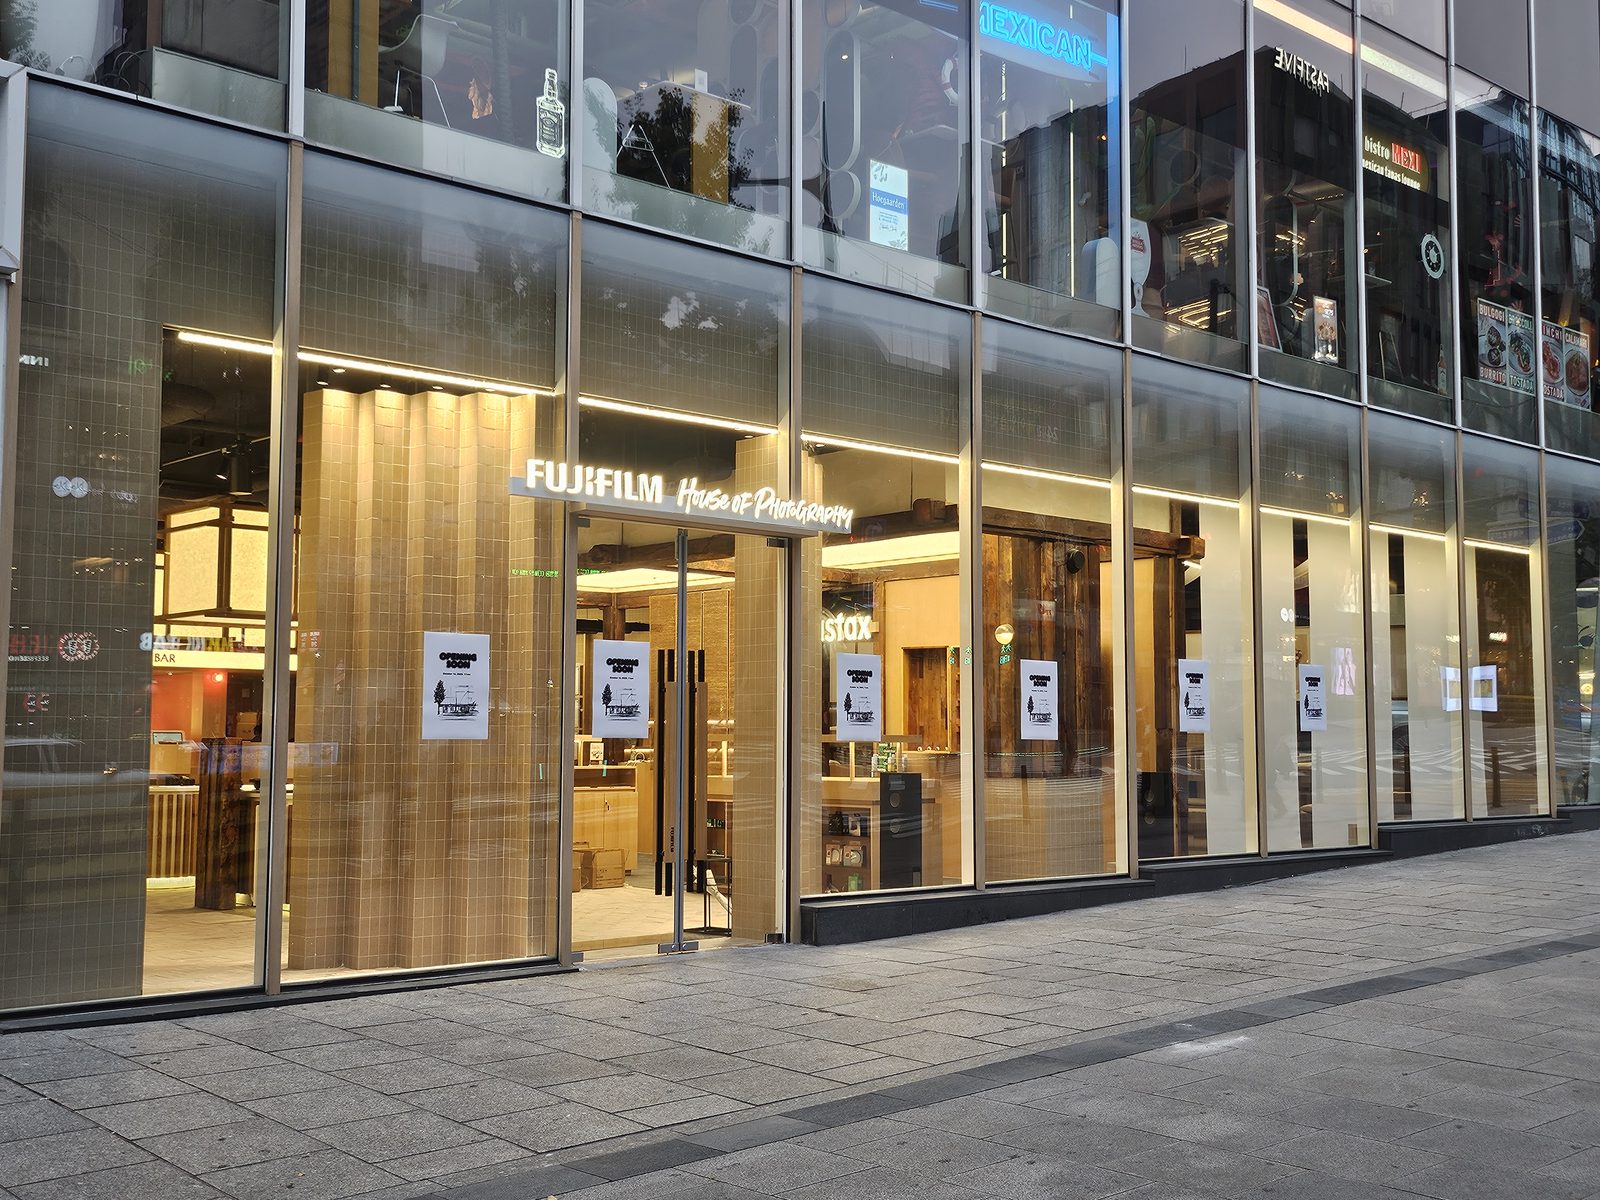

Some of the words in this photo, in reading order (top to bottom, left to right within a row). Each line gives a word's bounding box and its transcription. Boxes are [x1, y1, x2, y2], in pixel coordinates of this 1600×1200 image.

[1364, 136, 1390, 160] bistro
[1391, 143, 1421, 174] MEXI
[872, 191, 905, 210] Hoegaarden
[1479, 303, 1505, 322] BULGOGI
[1542, 325, 1562, 341] IMCHI
[1479, 366, 1506, 384] BURRITO
[1510, 374, 1533, 392] TOSTADA
[1543, 384, 1564, 400] OSTADA
[526, 458, 663, 504] FUJIFILM
[154, 652, 176, 663] BAR
[439, 651, 477, 662] OPENING
[446, 660, 471, 669] SOON
